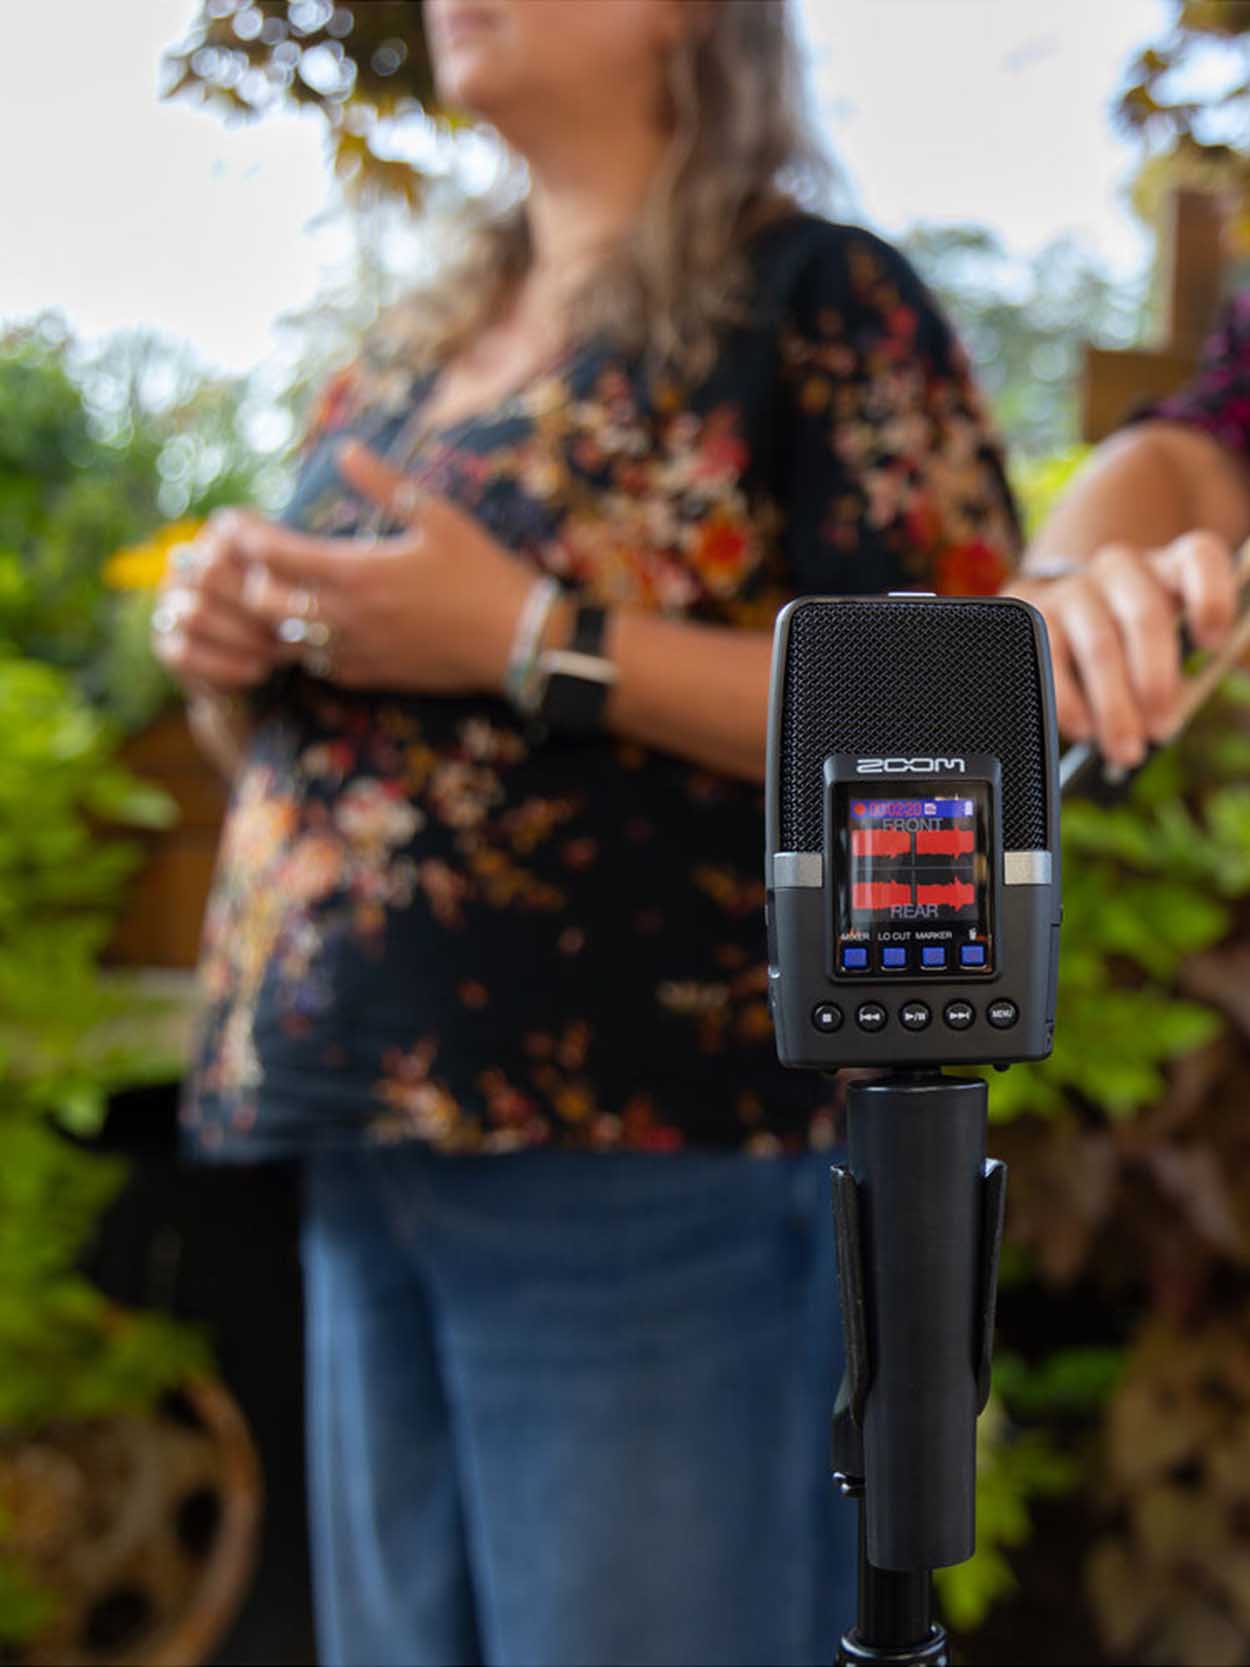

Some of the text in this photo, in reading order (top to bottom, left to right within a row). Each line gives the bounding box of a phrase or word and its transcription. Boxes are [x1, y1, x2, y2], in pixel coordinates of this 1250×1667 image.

[856, 758, 966, 773] ZOOM
[882, 818, 943, 832] FRONT
[890, 904, 939, 919] REAR
[892, 932, 912, 941] CUT
[915, 931, 953, 940] MARKER
[991, 1009, 1013, 1018] MENU
